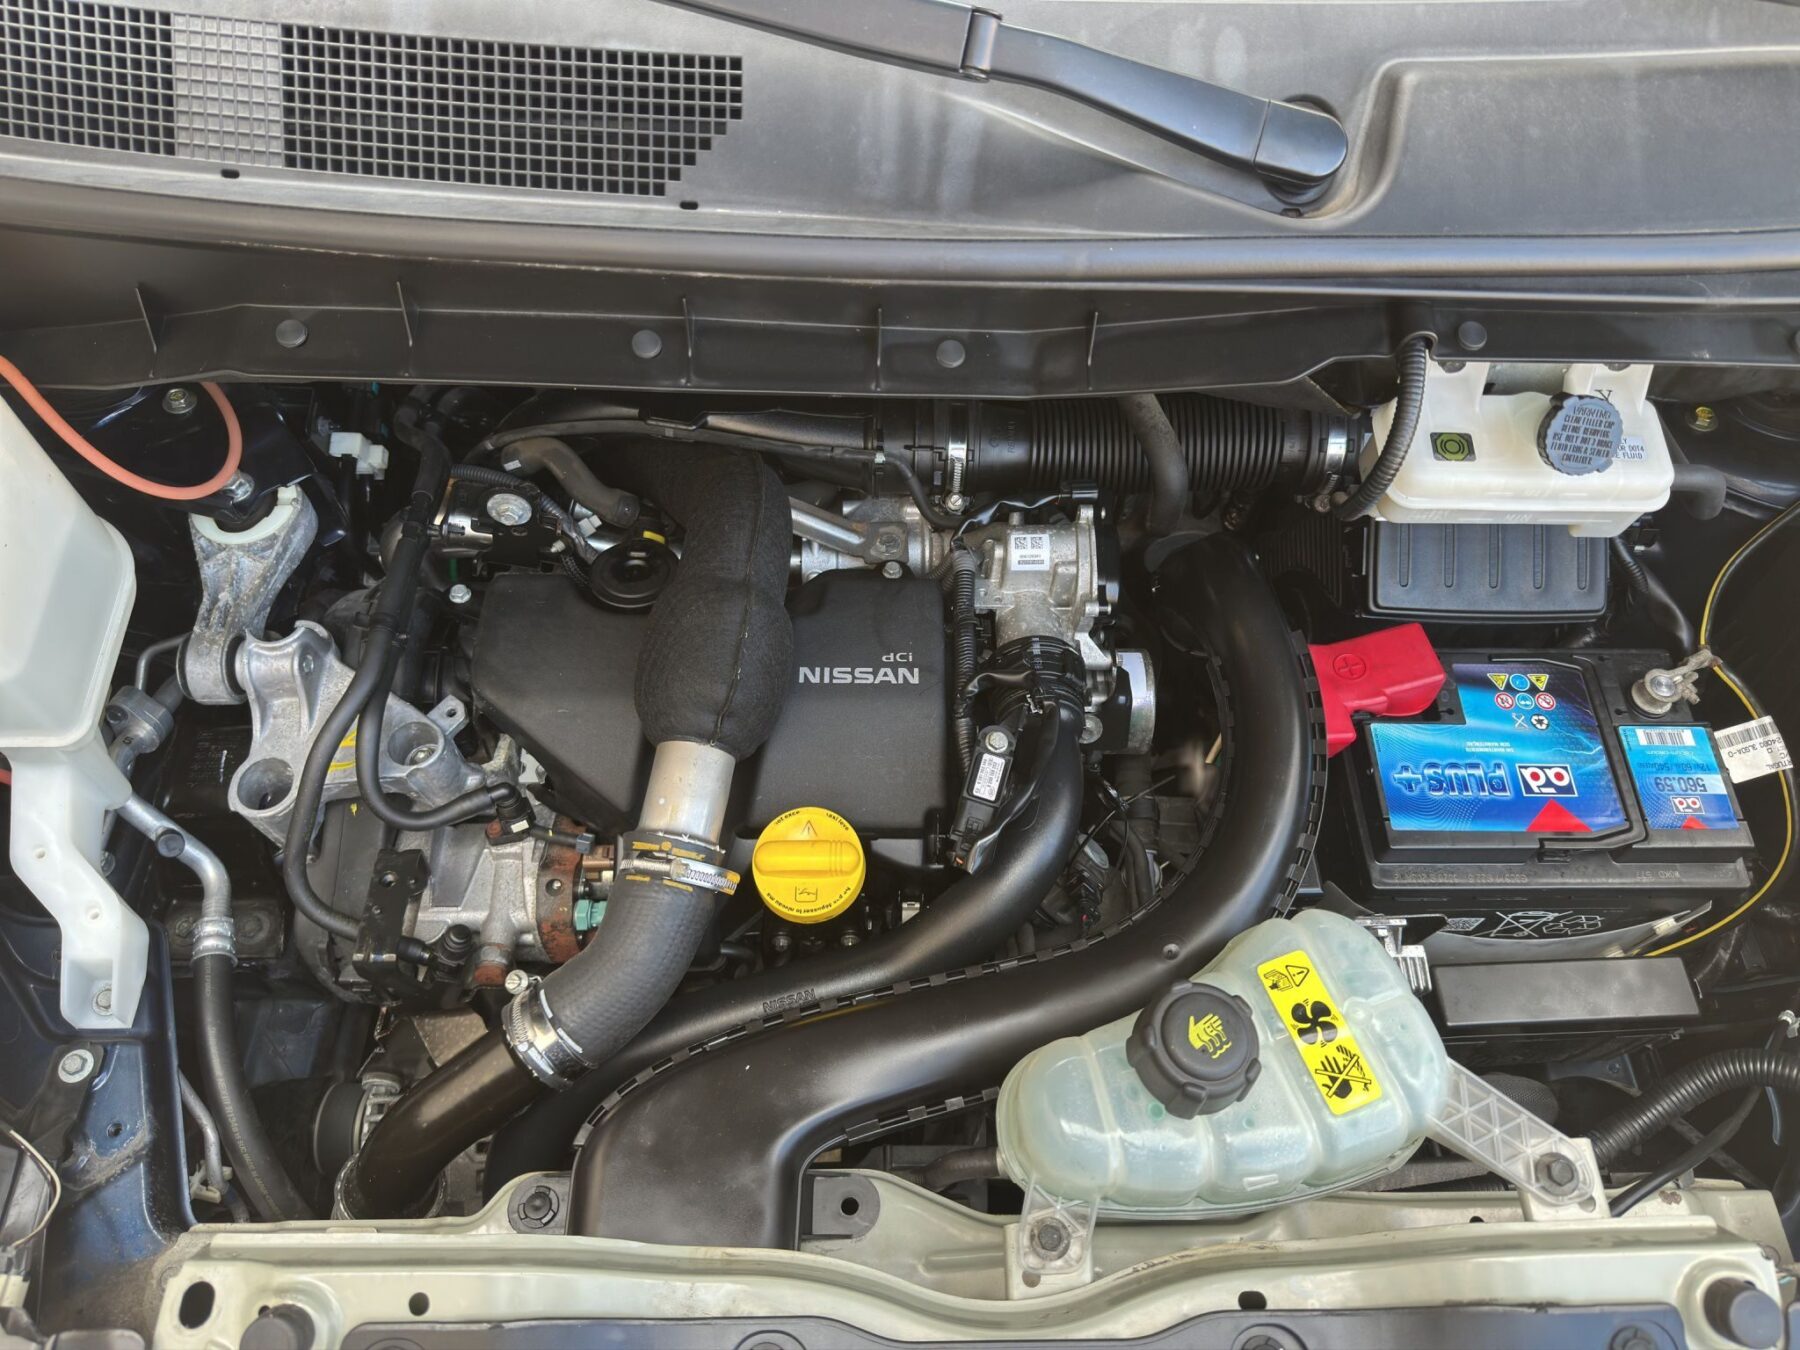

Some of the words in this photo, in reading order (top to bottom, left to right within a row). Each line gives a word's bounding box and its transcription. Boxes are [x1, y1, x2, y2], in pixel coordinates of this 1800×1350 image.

[881, 652, 913, 663] dCi
[798, 667, 919, 685] NISSAN
[1392, 762, 1511, 797] PLUS+
[1654, 776, 1708, 793] 560.59
[762, 987, 816, 1013] NISSAN
